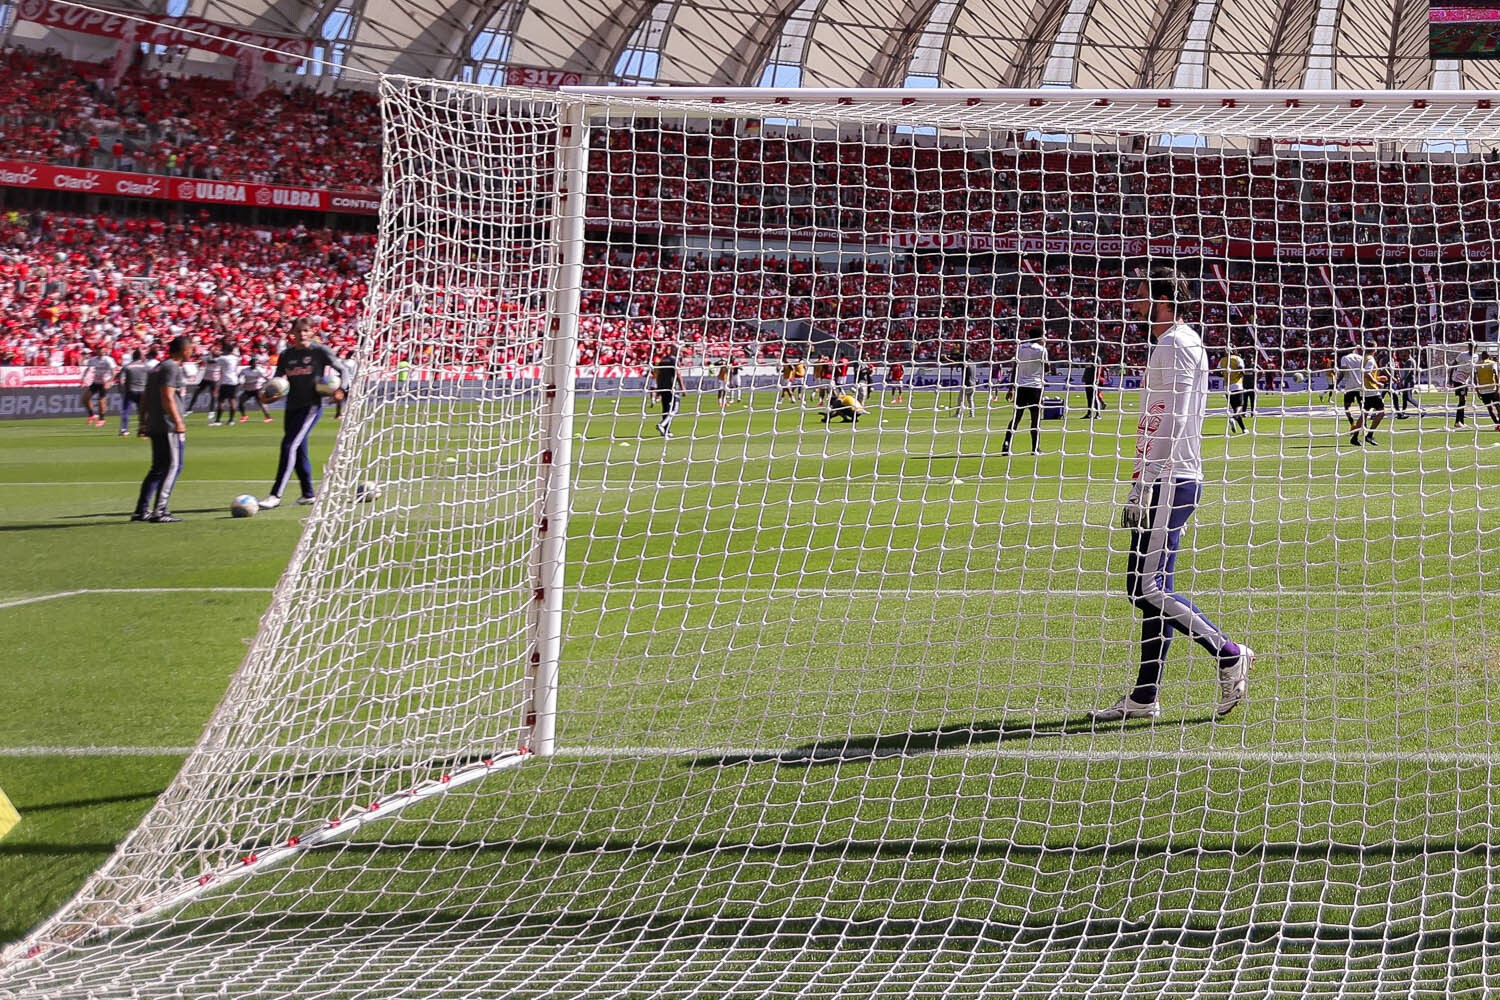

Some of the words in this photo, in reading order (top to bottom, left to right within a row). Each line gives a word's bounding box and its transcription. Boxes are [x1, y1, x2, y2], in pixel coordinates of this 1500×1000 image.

[46, 2, 144, 35] SUPER
[524, 69, 565, 85] 317
[0, 167, 36, 184] laro
[54, 173, 99, 189] Claro
[116, 179, 159, 195] Claro
[196, 183, 246, 201] ULBRA
[272, 190, 320, 207] ULBRA
[332, 197, 382, 209] CONTIG
